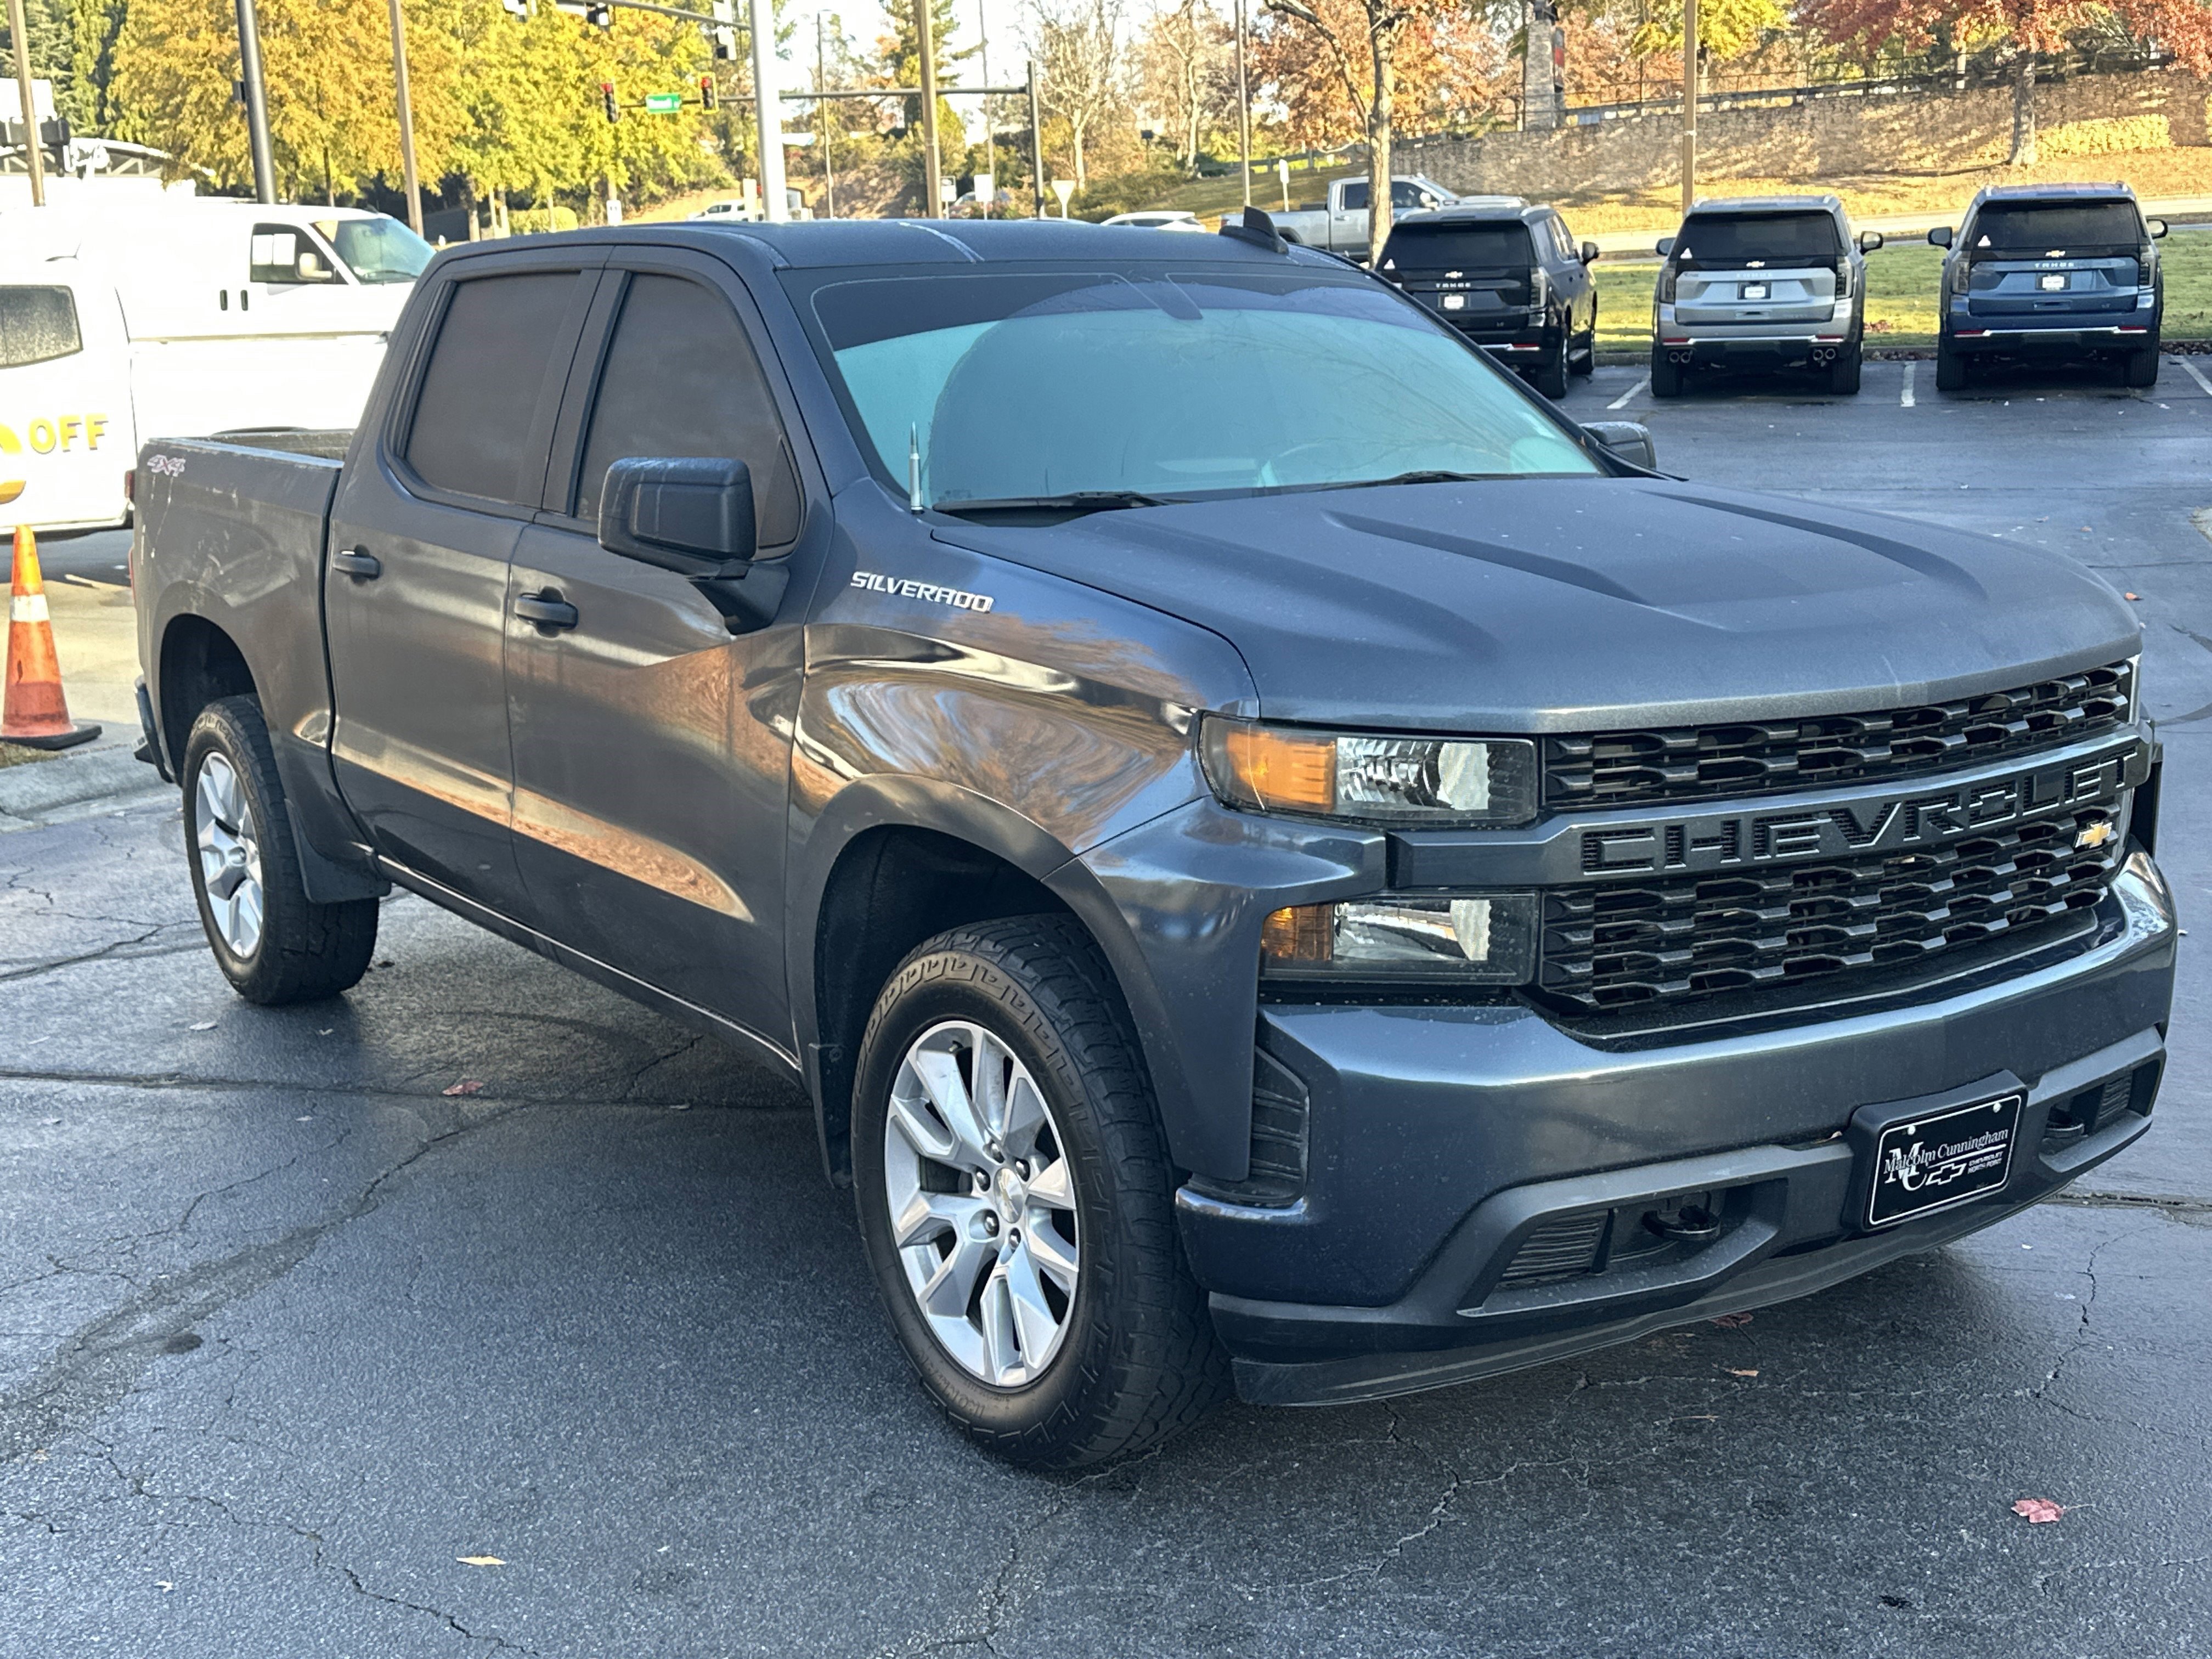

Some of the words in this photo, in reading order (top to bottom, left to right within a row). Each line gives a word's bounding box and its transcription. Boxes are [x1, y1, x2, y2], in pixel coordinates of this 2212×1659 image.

[28, 414, 109, 455] OFF
[850, 571, 994, 613] SILVERADO
[1581, 745, 2138, 876] CHEVROLET
[1883, 1149, 1936, 1175] Malcolm
[1937, 1128, 2009, 1159] Cunningham
